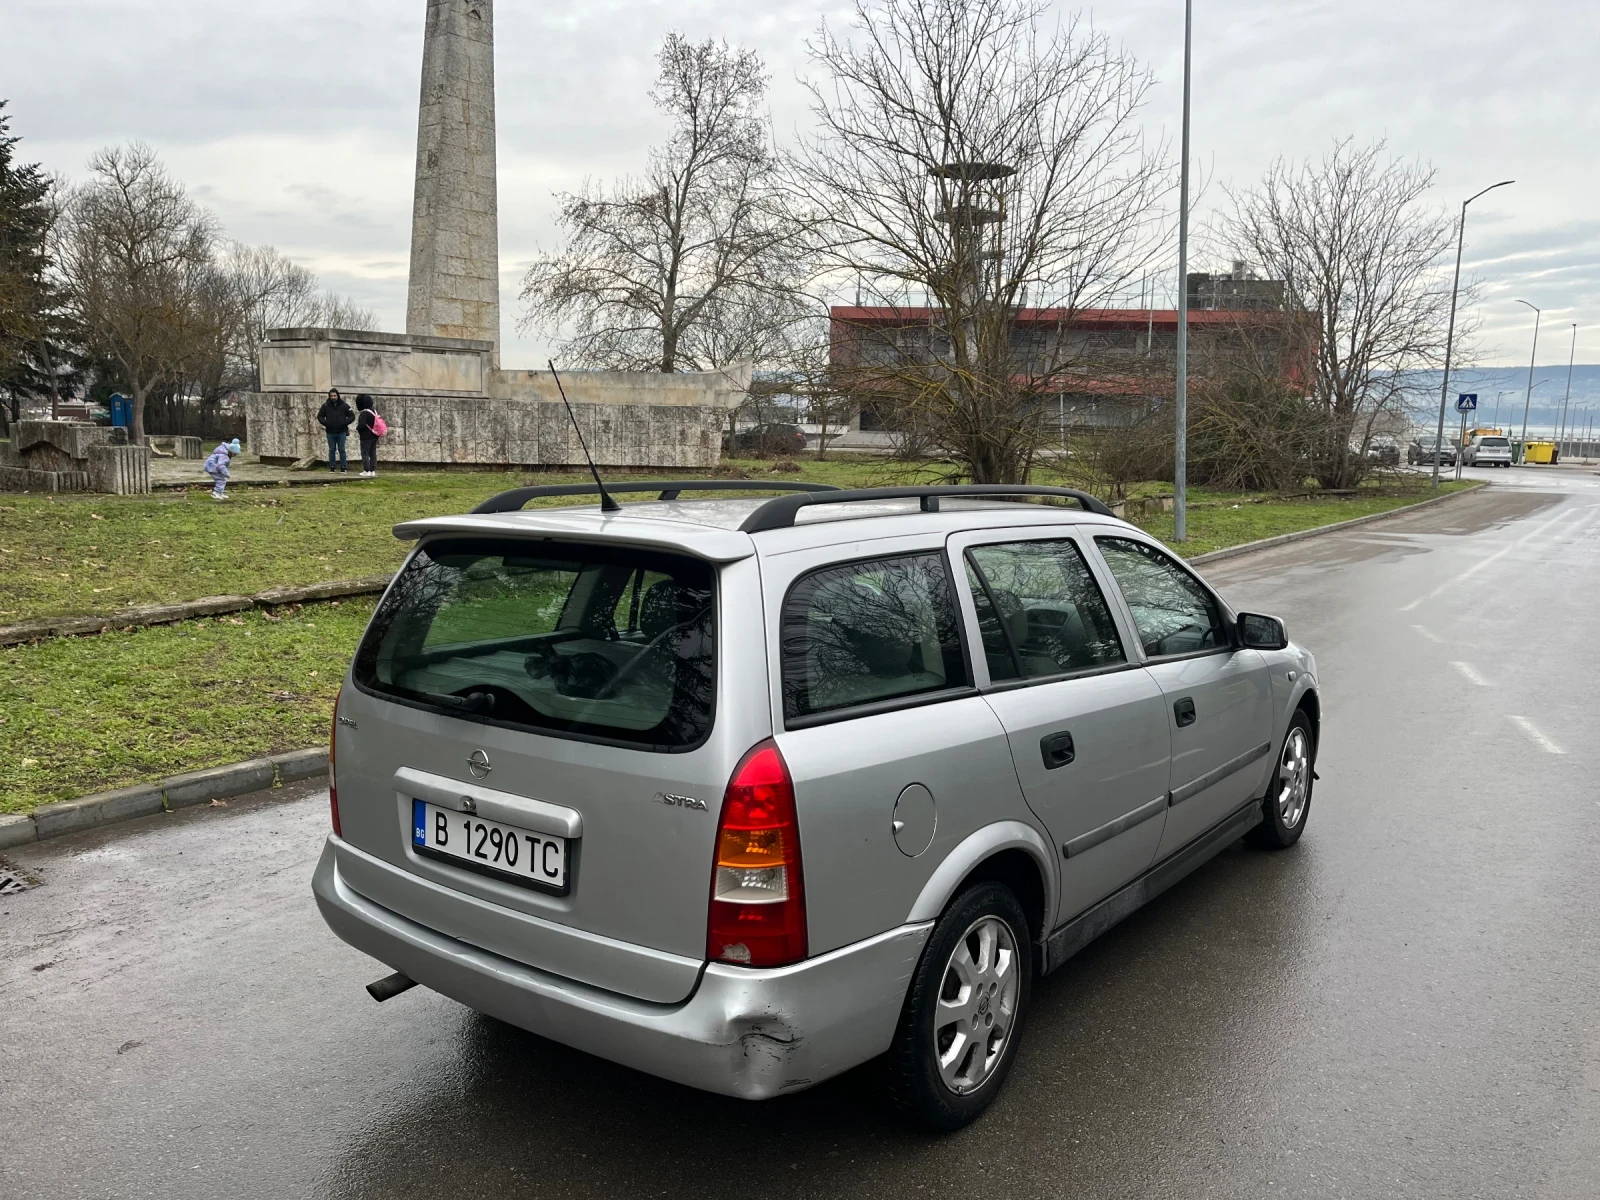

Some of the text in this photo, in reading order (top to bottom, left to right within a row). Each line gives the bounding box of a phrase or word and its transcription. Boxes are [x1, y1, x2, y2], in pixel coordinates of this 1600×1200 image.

[415, 827, 425, 839] BG
[435, 811, 559, 878] B 1290 TC
